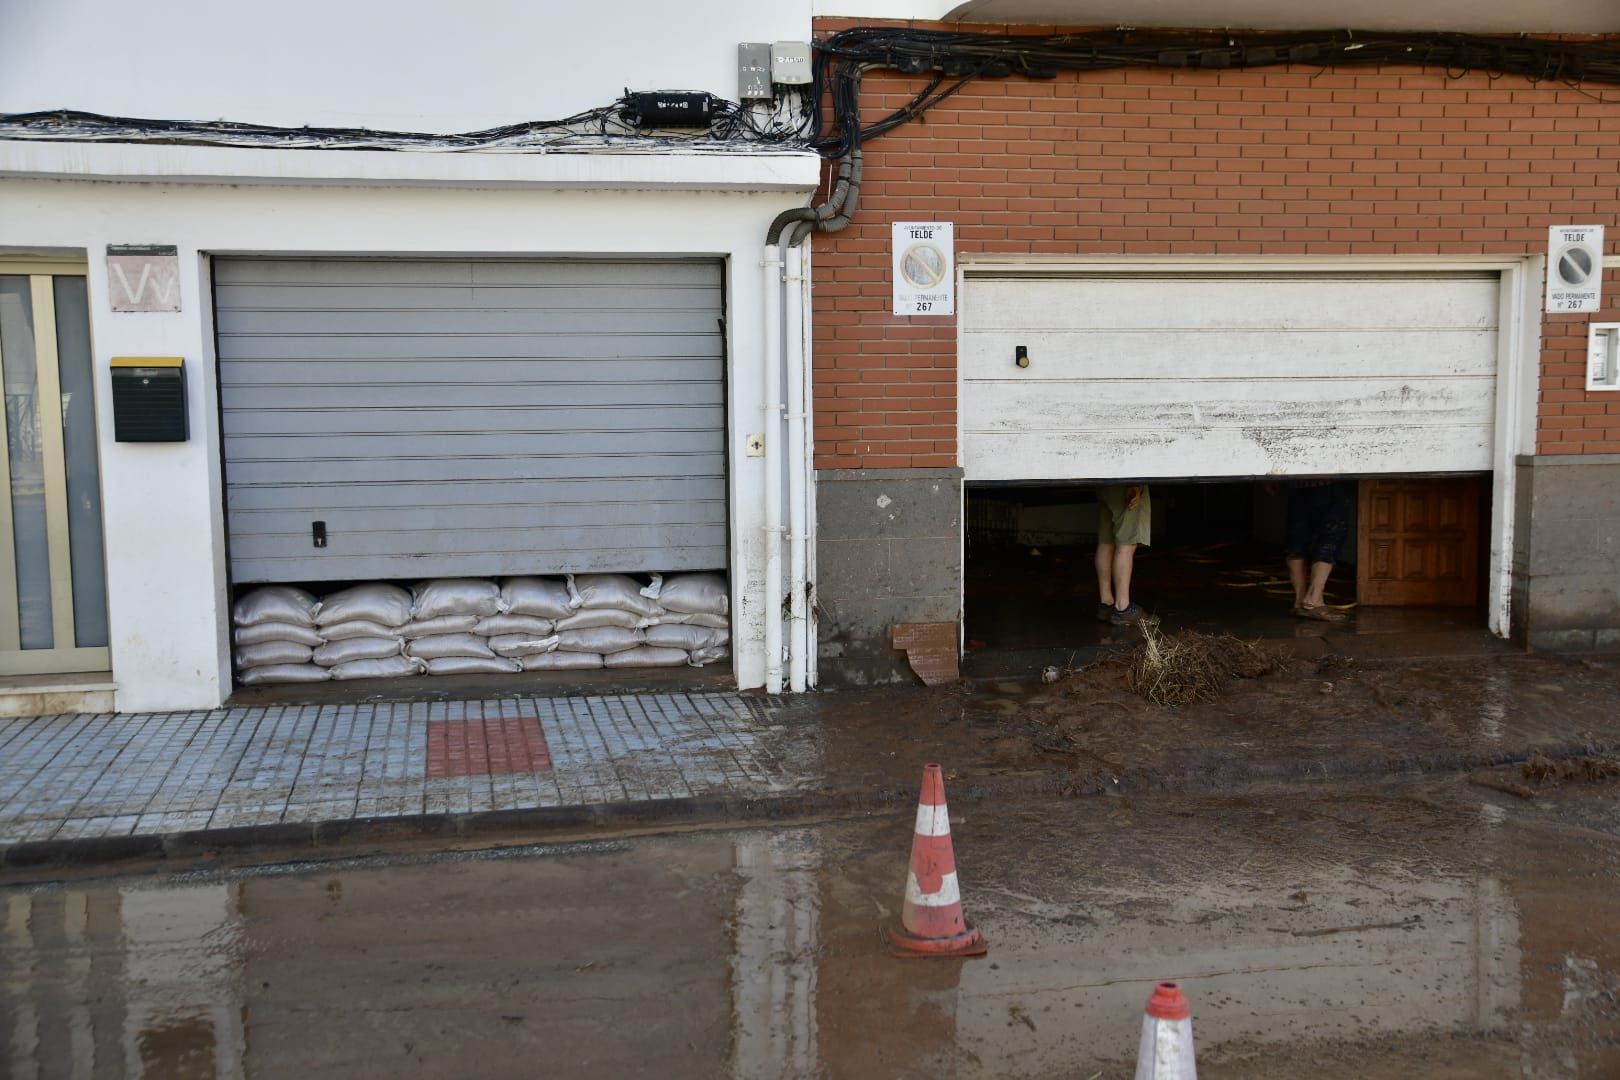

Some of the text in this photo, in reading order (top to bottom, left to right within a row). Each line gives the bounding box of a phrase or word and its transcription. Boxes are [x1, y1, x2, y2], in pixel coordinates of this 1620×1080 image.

[910, 230, 933, 239] TELDE
[1563, 233, 1585, 241] TELDE
[916, 302, 932, 311] 267
[1568, 300, 1583, 309] 267
